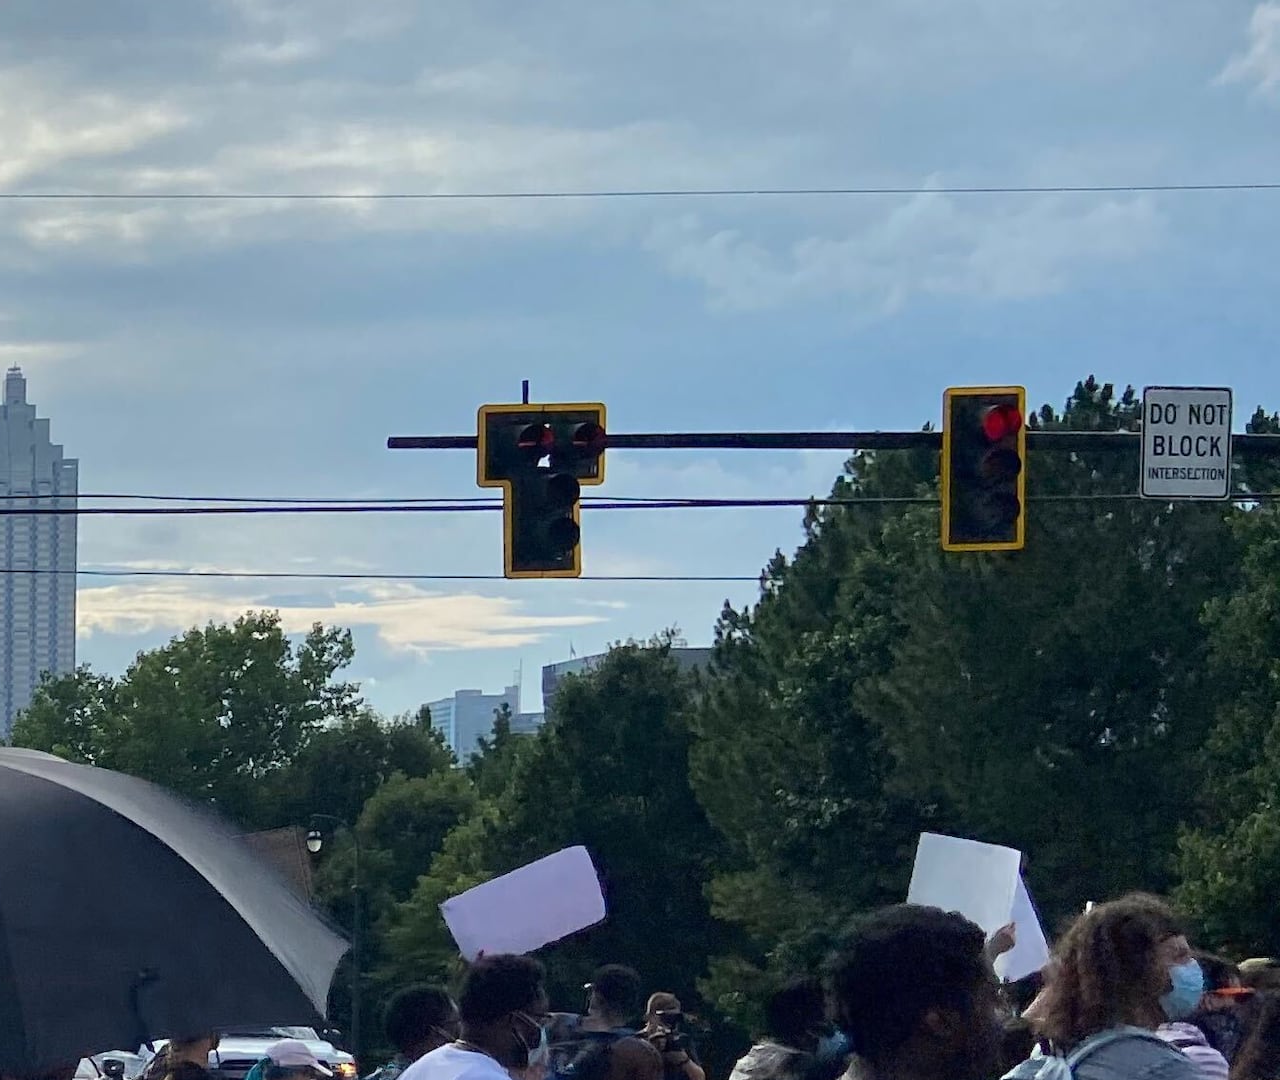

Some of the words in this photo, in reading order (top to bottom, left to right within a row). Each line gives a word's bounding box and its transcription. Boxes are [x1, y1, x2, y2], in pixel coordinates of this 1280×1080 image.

[1150, 403, 1177, 425] DO
[1188, 404, 1228, 425] NOT
[1153, 435, 1222, 457] BLOCK
[1148, 467, 1225, 480] INTERSECTION
